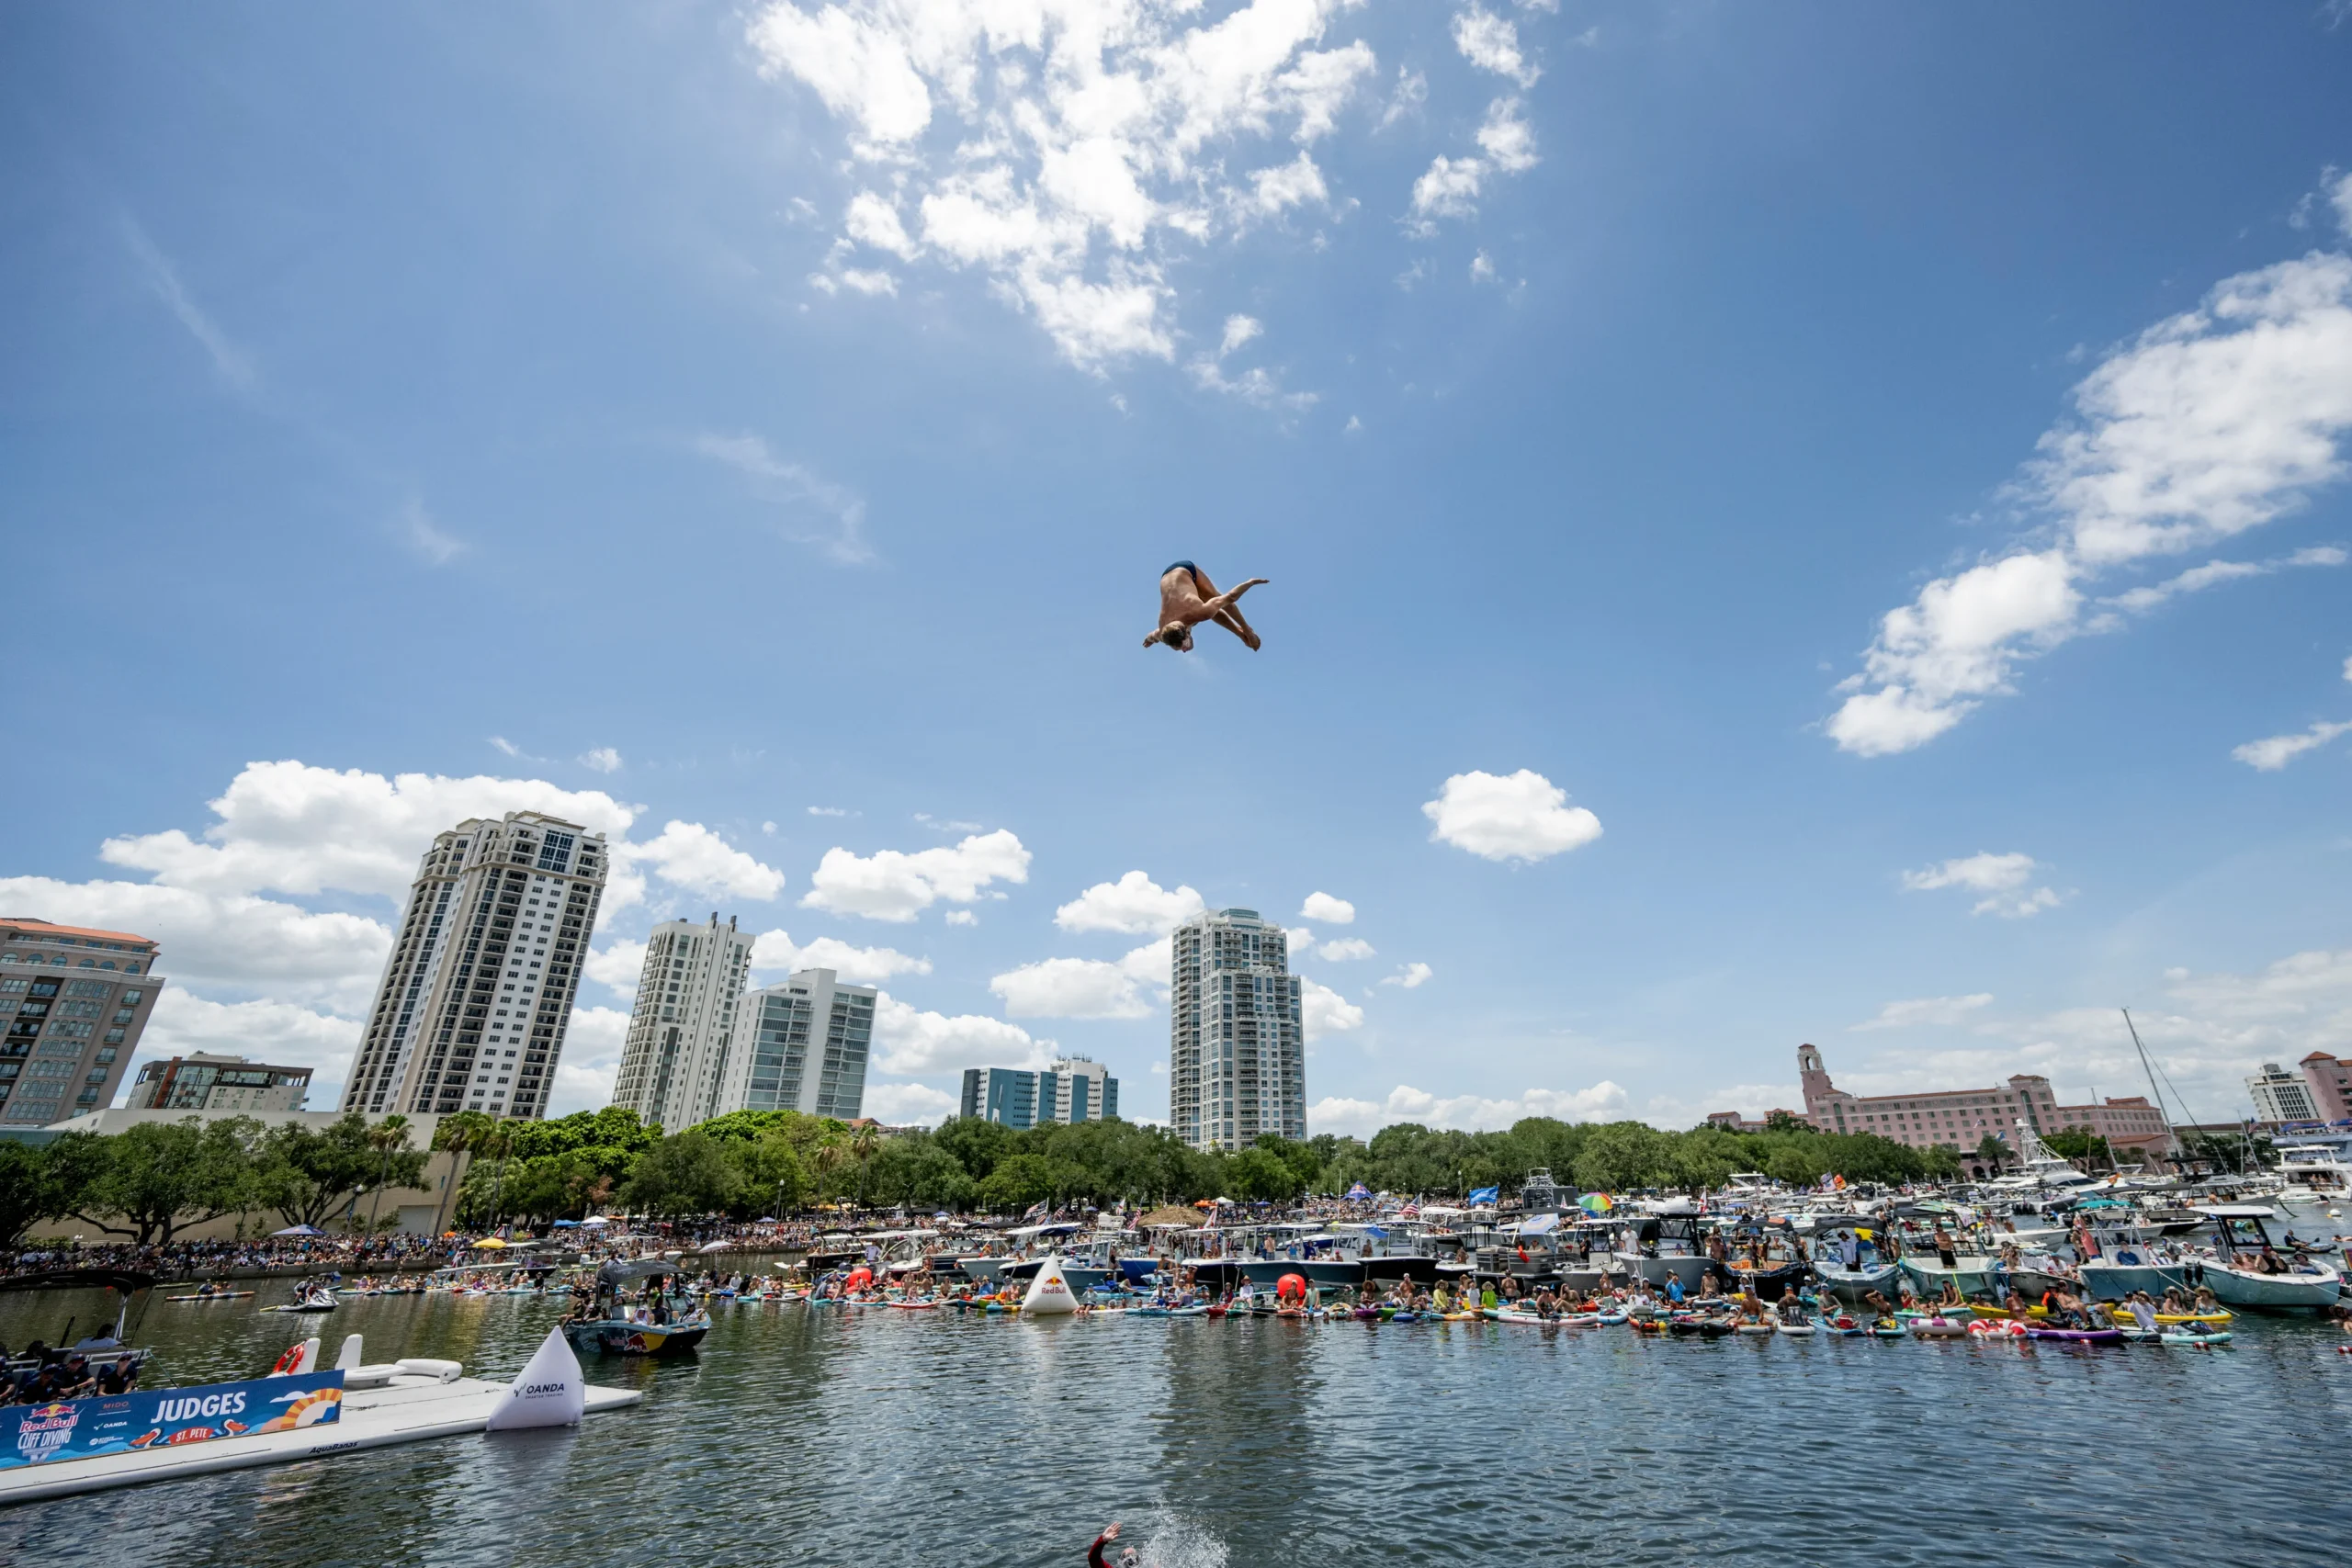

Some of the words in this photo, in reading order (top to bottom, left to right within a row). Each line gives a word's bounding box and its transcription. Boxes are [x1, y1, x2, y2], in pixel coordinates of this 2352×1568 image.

[1055, 1286, 1067, 1294] Bull
[526, 1382, 564, 1394] OANDA
[102, 1401, 129, 1410] MIDO
[150, 1392, 247, 1424] JUDGES
[18, 1418, 49, 1433] Red
[50, 1415, 80, 1429] Bull
[17, 1431, 42, 1450] CLIFF
[40, 1427, 74, 1448] DIVING
[175, 1431, 187, 1442] ST.
[189, 1427, 209, 1438] PETE
[308, 1441, 359, 1454] AquaBanas
